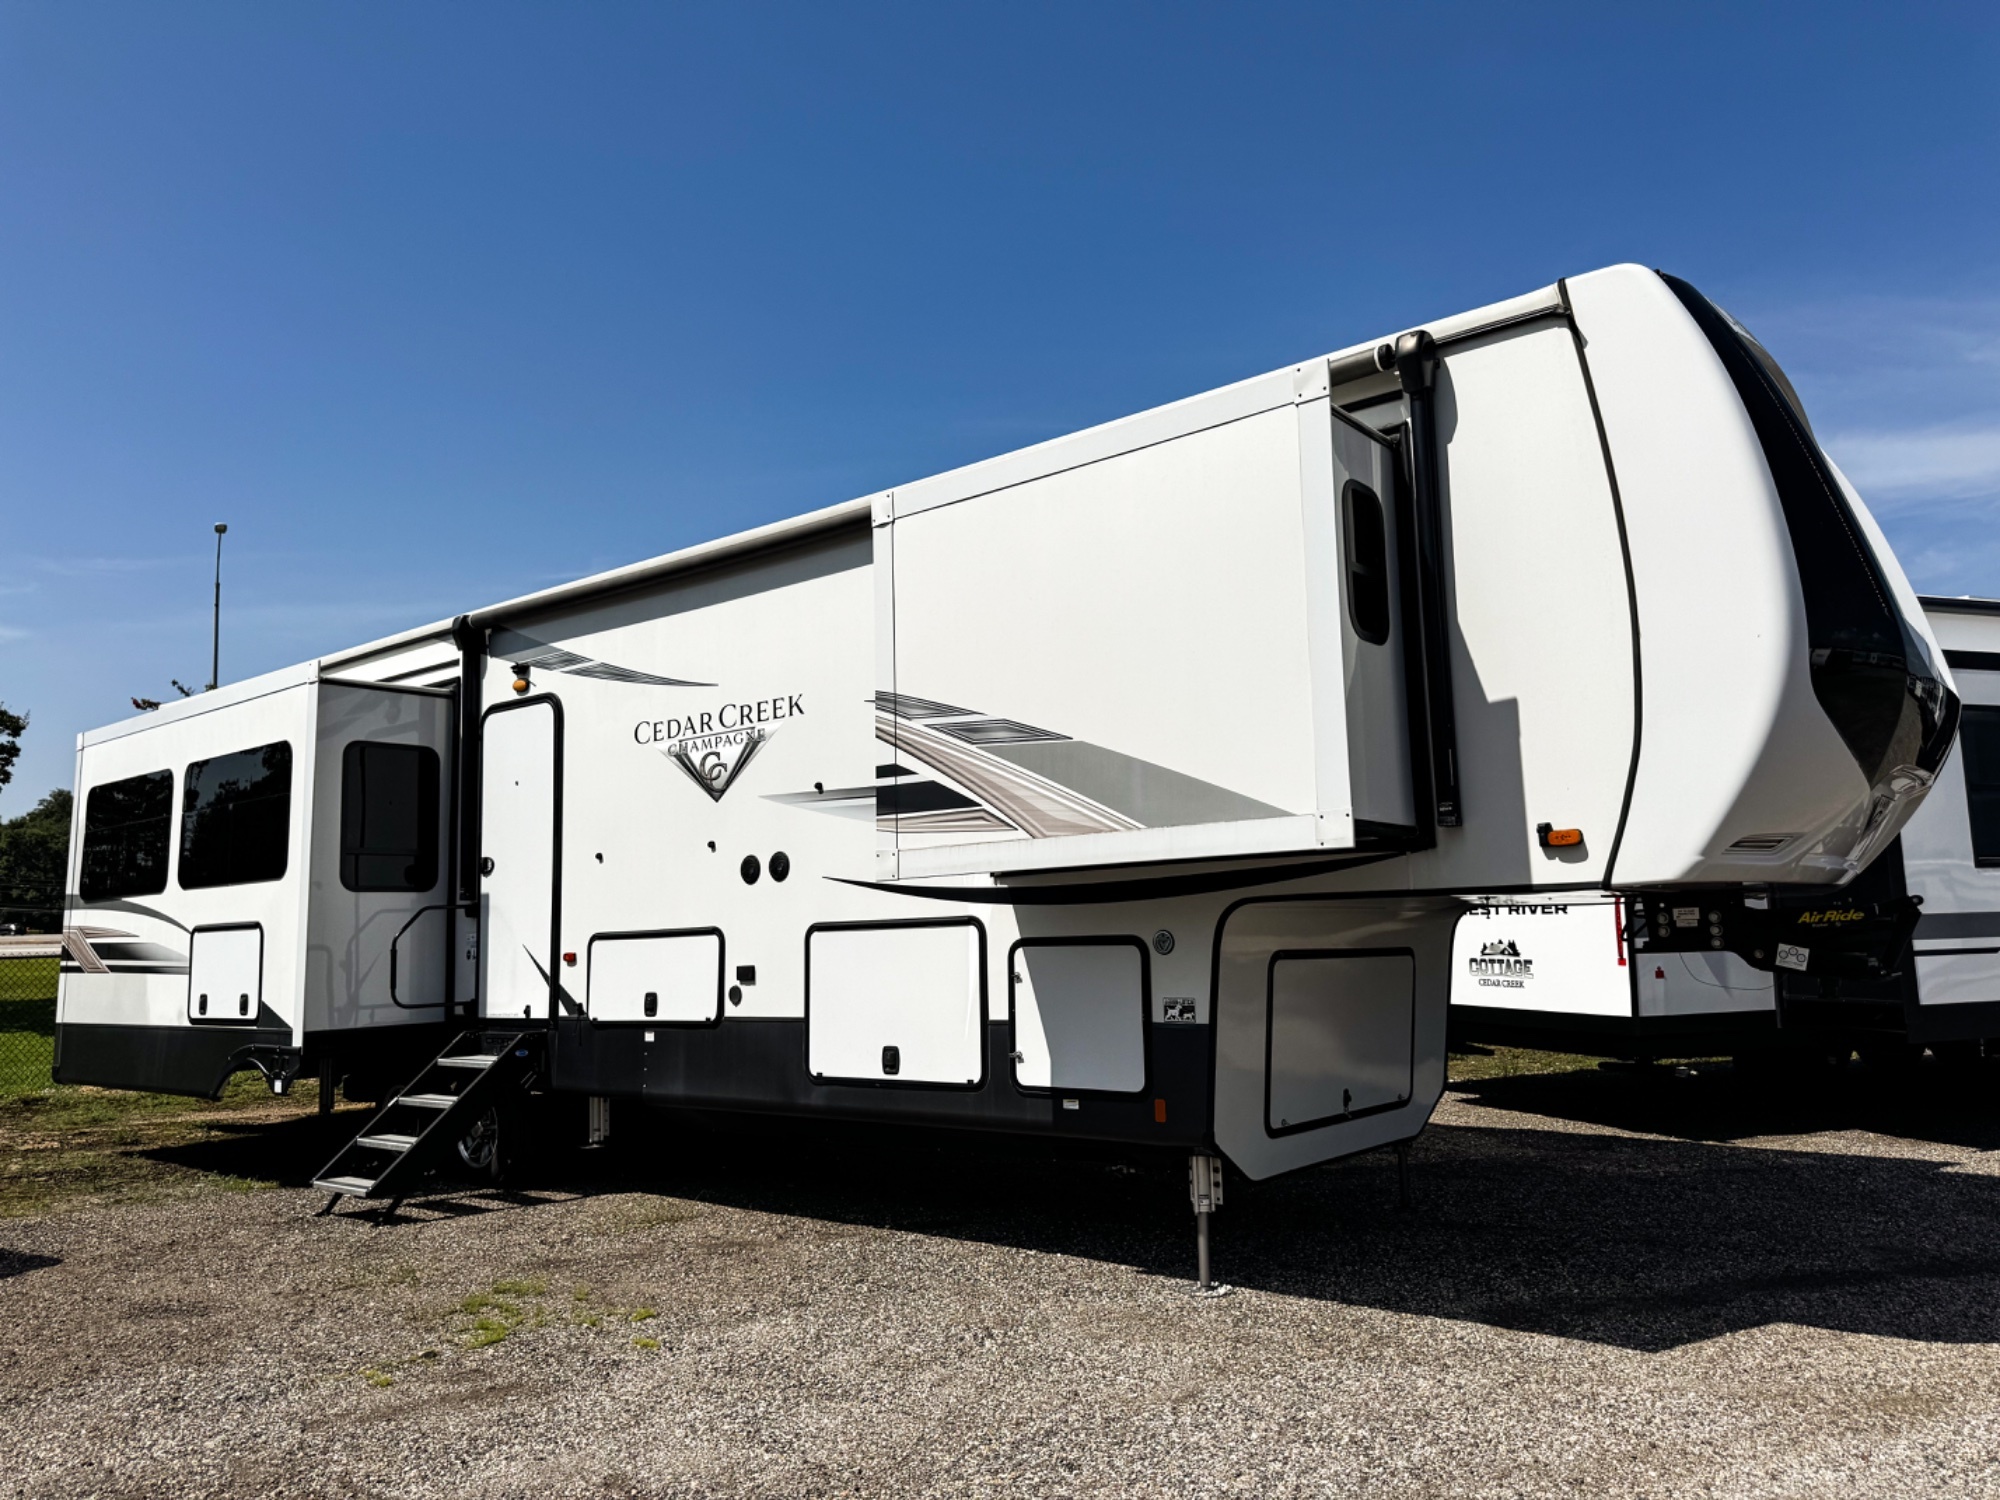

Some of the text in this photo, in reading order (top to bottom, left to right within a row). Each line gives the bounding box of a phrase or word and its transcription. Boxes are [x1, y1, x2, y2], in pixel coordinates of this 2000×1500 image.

[634, 693, 805, 744] CEDAR CREEK
[667, 728, 766, 756] CHAMPAGNE
[1508, 905, 1568, 915] RIVER
[1469, 958, 1534, 978] COTTAGE
[1478, 979, 1525, 988] CEDAR CREEK
